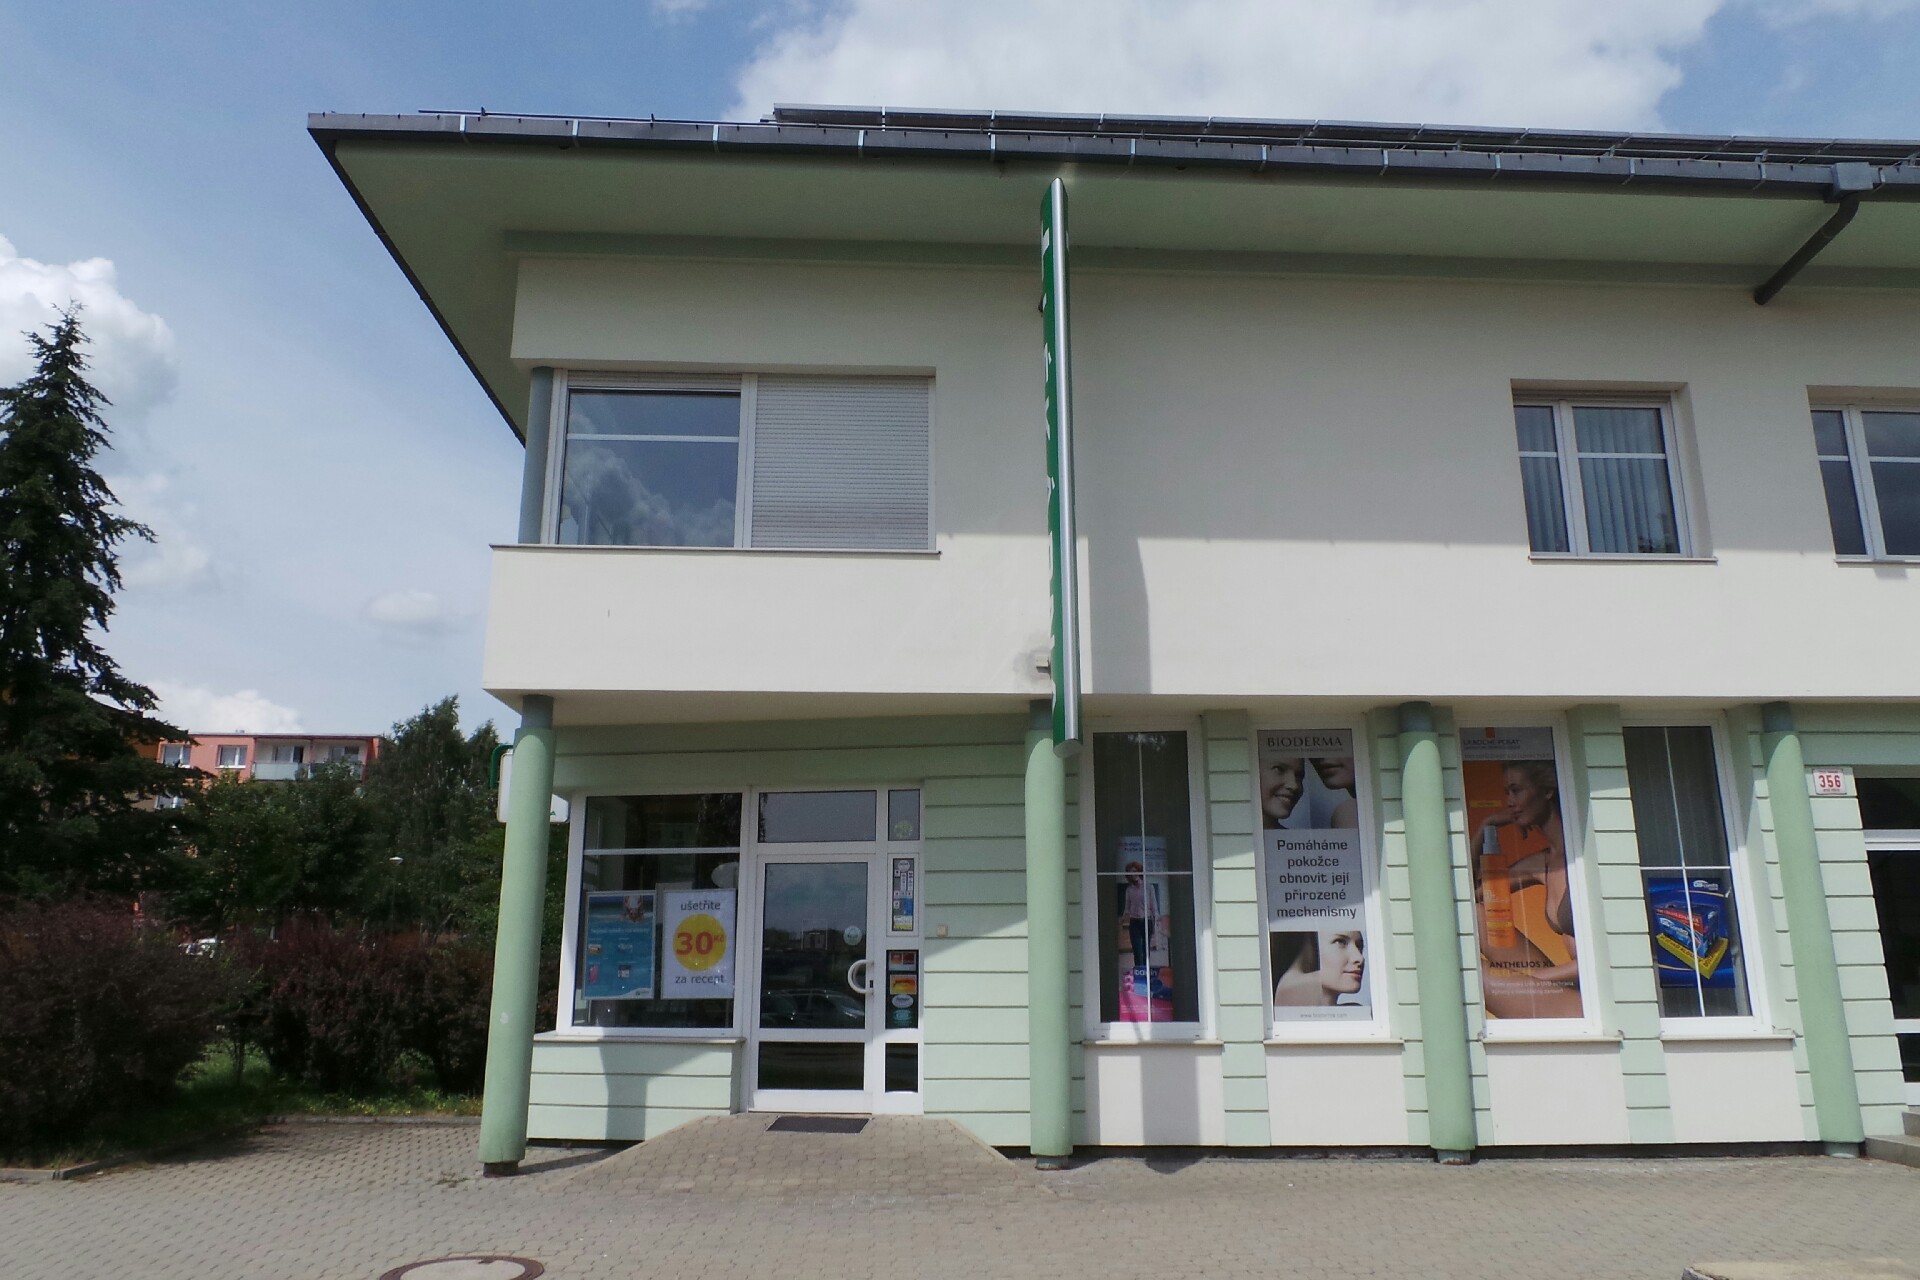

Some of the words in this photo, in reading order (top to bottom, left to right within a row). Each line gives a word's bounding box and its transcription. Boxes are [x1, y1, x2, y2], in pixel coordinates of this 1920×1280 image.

[1266, 736, 1343, 747] BIODERMA
[1818, 774, 1841, 788] 356
[1277, 839, 1348, 851] Pomáháme
[1287, 855, 1340, 868] pokožce
[1279, 872, 1328, 885] obnovit
[1331, 872, 1350, 886] její
[1284, 889, 1347, 902] přirozené
[1276, 906, 1357, 920] mechanismy
[675, 931, 714, 956] 30
[1489, 961, 1540, 969] ANTHELIOS
[675, 976, 687, 984] za
[690, 974, 725, 986] recept
